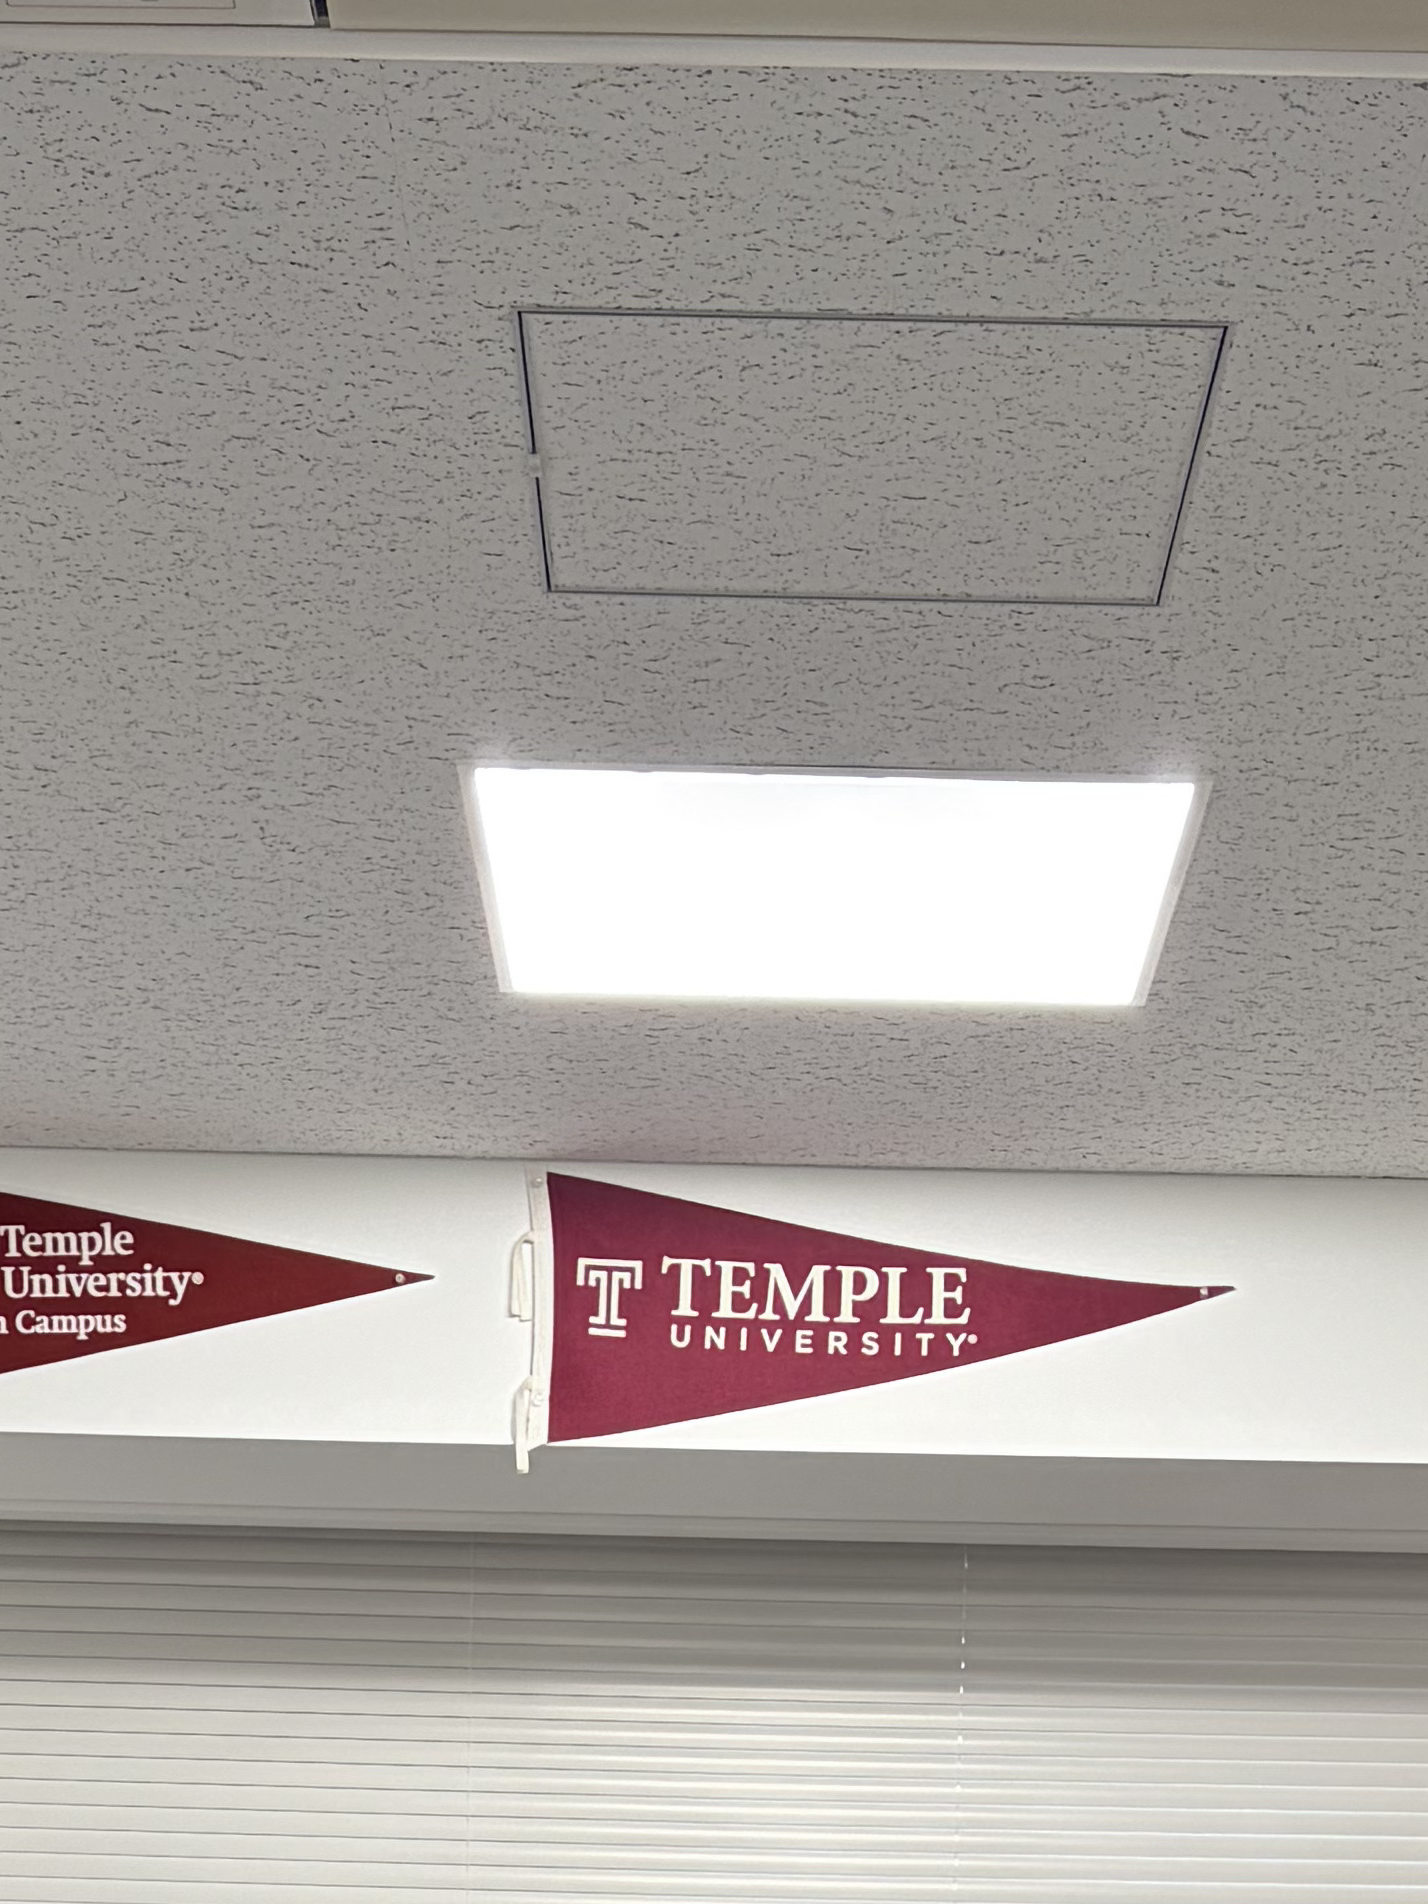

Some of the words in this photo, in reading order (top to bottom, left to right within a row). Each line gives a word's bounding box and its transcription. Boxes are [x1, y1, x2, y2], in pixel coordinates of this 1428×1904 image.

[0, 1222, 135, 1265] Temple
[0, 1263, 193, 1306] University
[576, 1257, 643, 1338] T
[661, 1255, 971, 1325] TEMPLE
[15, 1309, 127, 1340] Campus
[670, 1324, 967, 1356] UNIVERSITY
